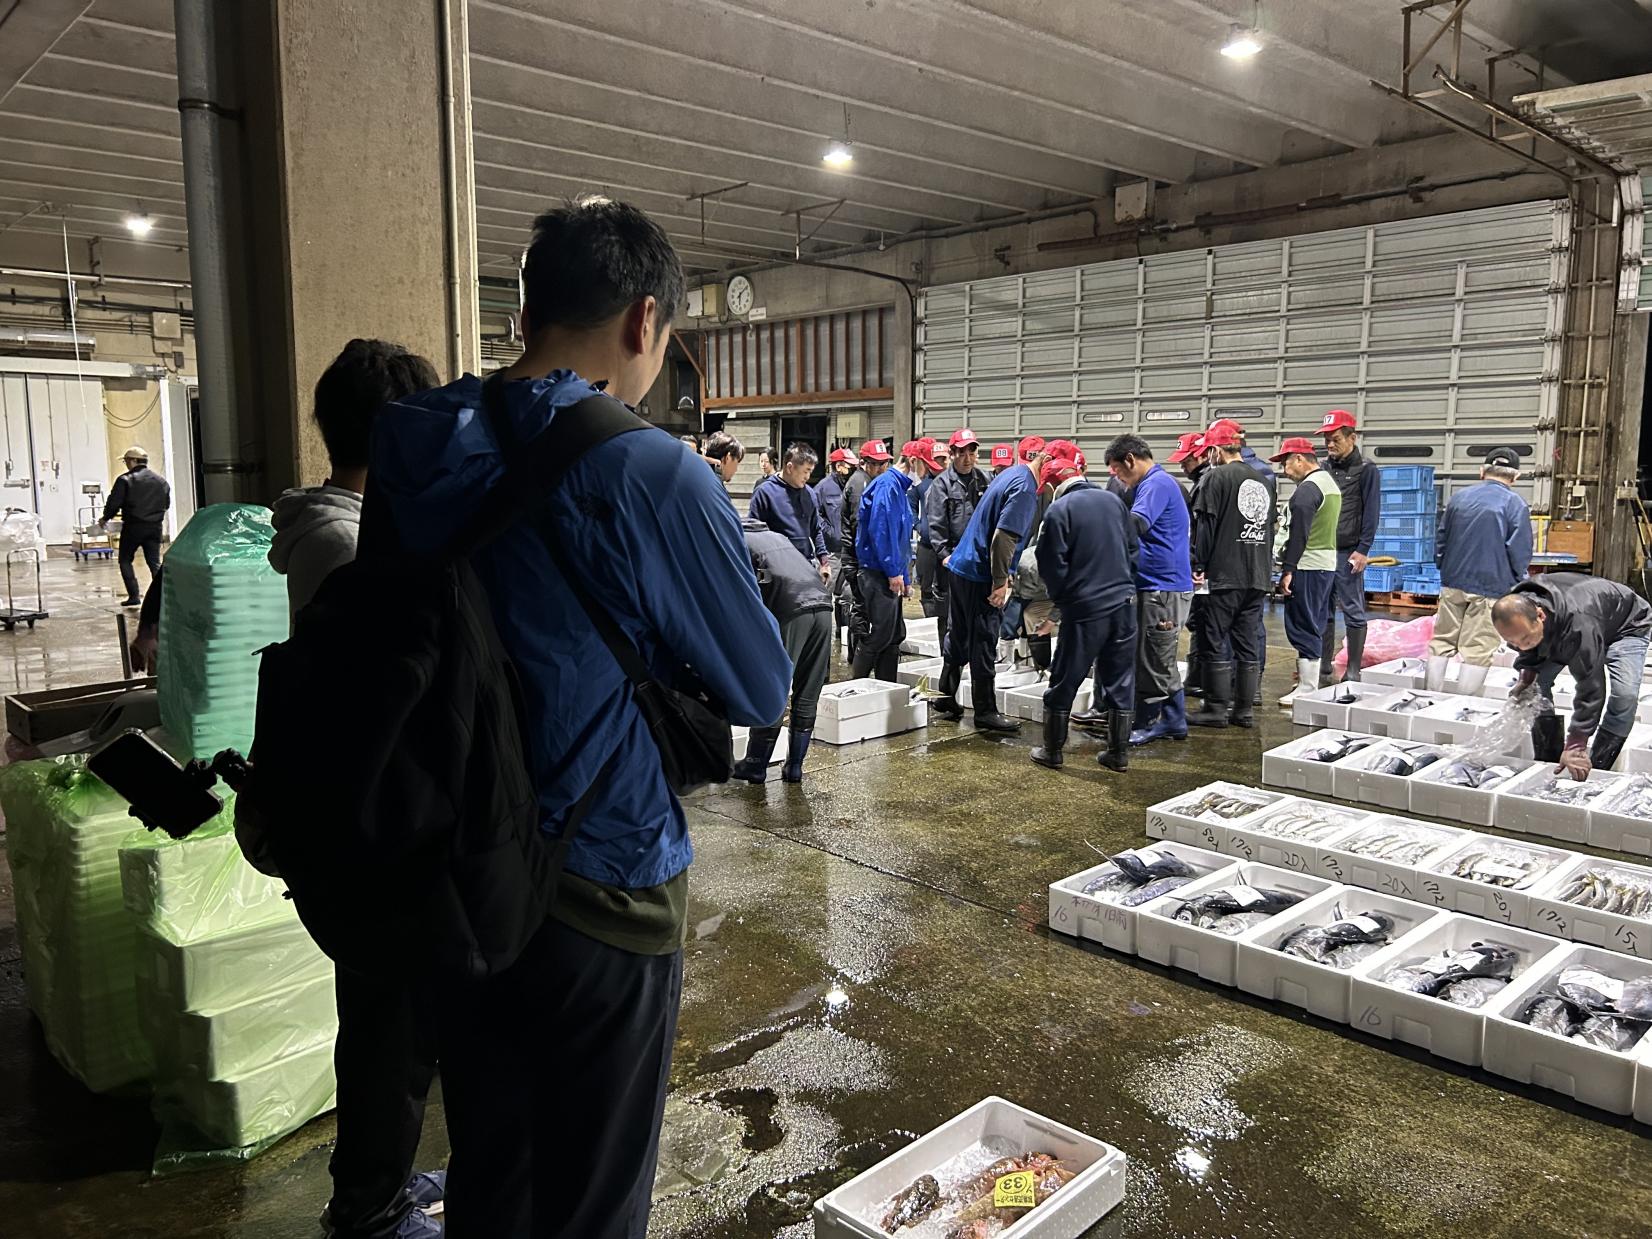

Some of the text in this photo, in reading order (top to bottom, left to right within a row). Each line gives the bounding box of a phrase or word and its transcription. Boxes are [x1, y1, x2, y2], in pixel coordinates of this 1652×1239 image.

[1053, 905, 1068, 922] 16
[1360, 1005, 1382, 1026] 16
[1003, 1177, 1023, 1190] 33
